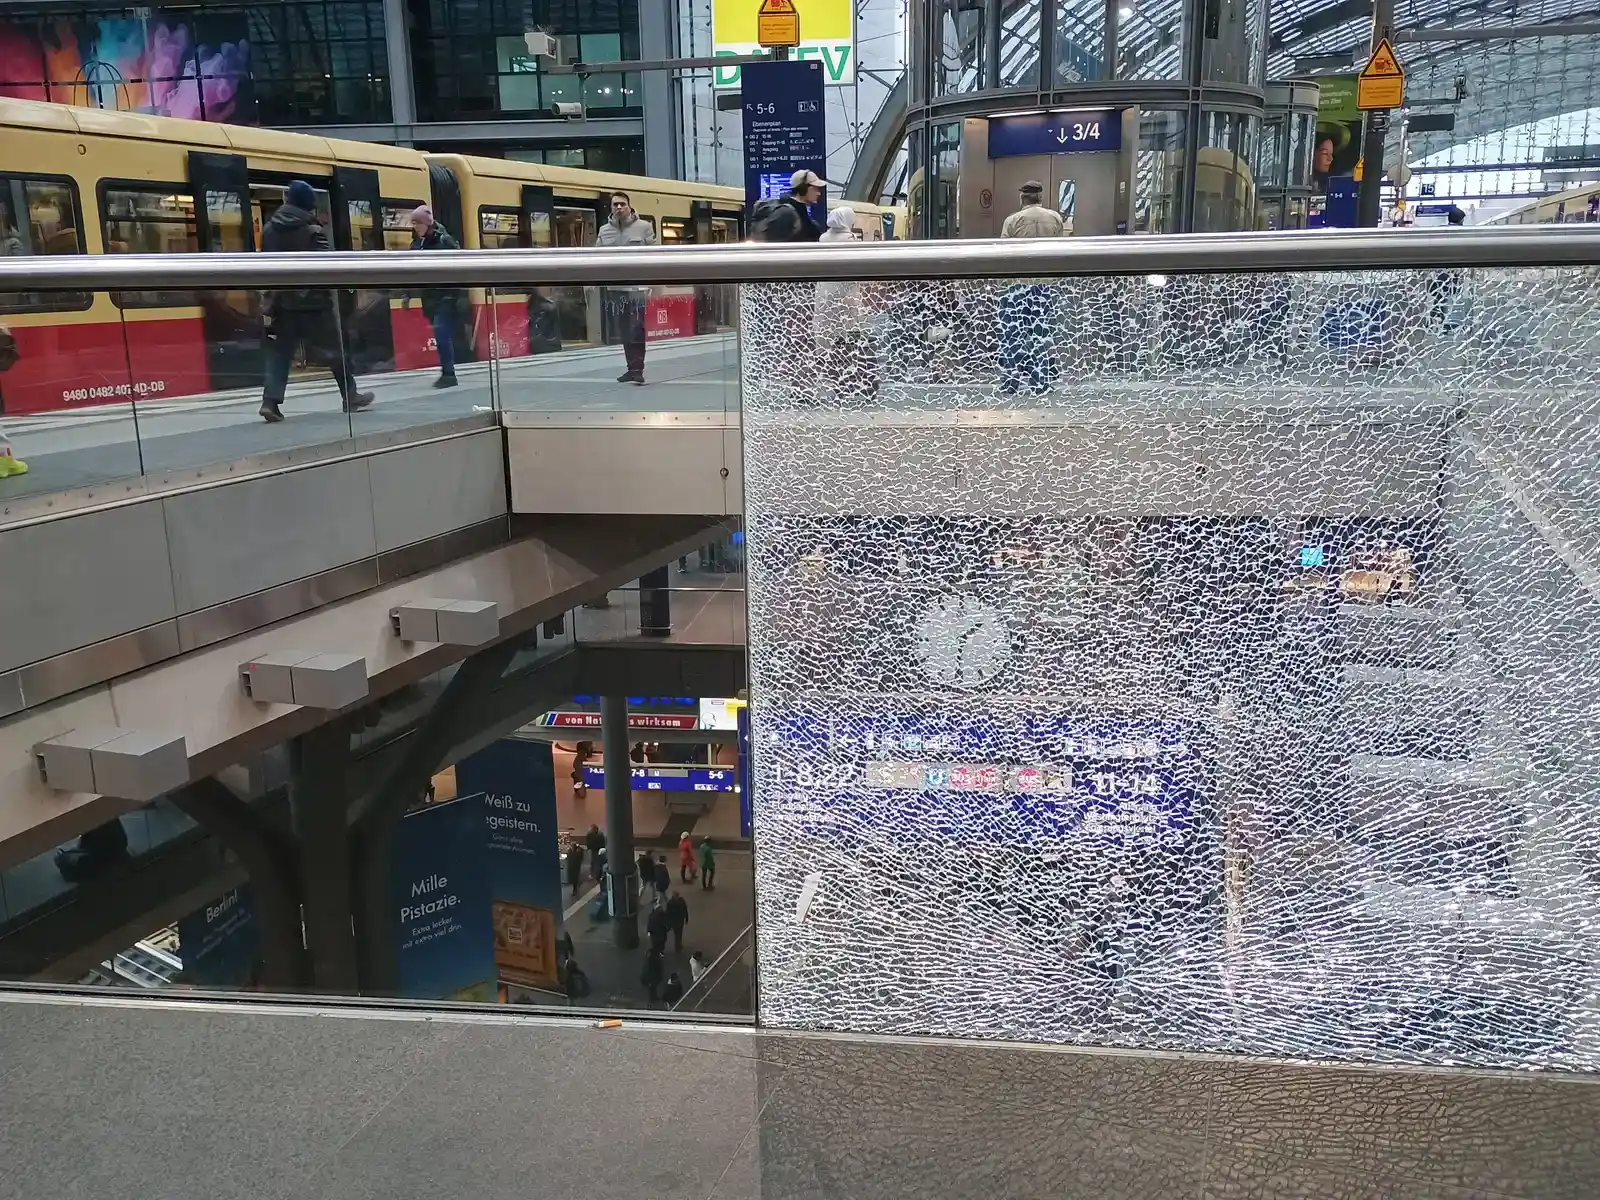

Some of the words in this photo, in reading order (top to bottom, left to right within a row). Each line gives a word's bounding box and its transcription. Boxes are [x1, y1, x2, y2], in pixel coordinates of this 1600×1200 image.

[756, 102, 775, 115] 5-6
[1072, 122, 1101, 141] 3/4
[1423, 183, 1435, 193] 15
[658, 310, 668, 323] DB
[62, 387, 88, 402] 9480
[89, 385, 115, 399] 0482
[565, 717, 583, 725] von
[637, 716, 682, 727] wirksam
[631, 768, 645, 778] 7-8
[708, 770, 724, 780] 5-6
[1092, 771, 1161, 794] 11-14
[516, 801, 531, 813] zu
[411, 873, 448, 898] Mille
[400, 893, 462, 924] Pistazie.
